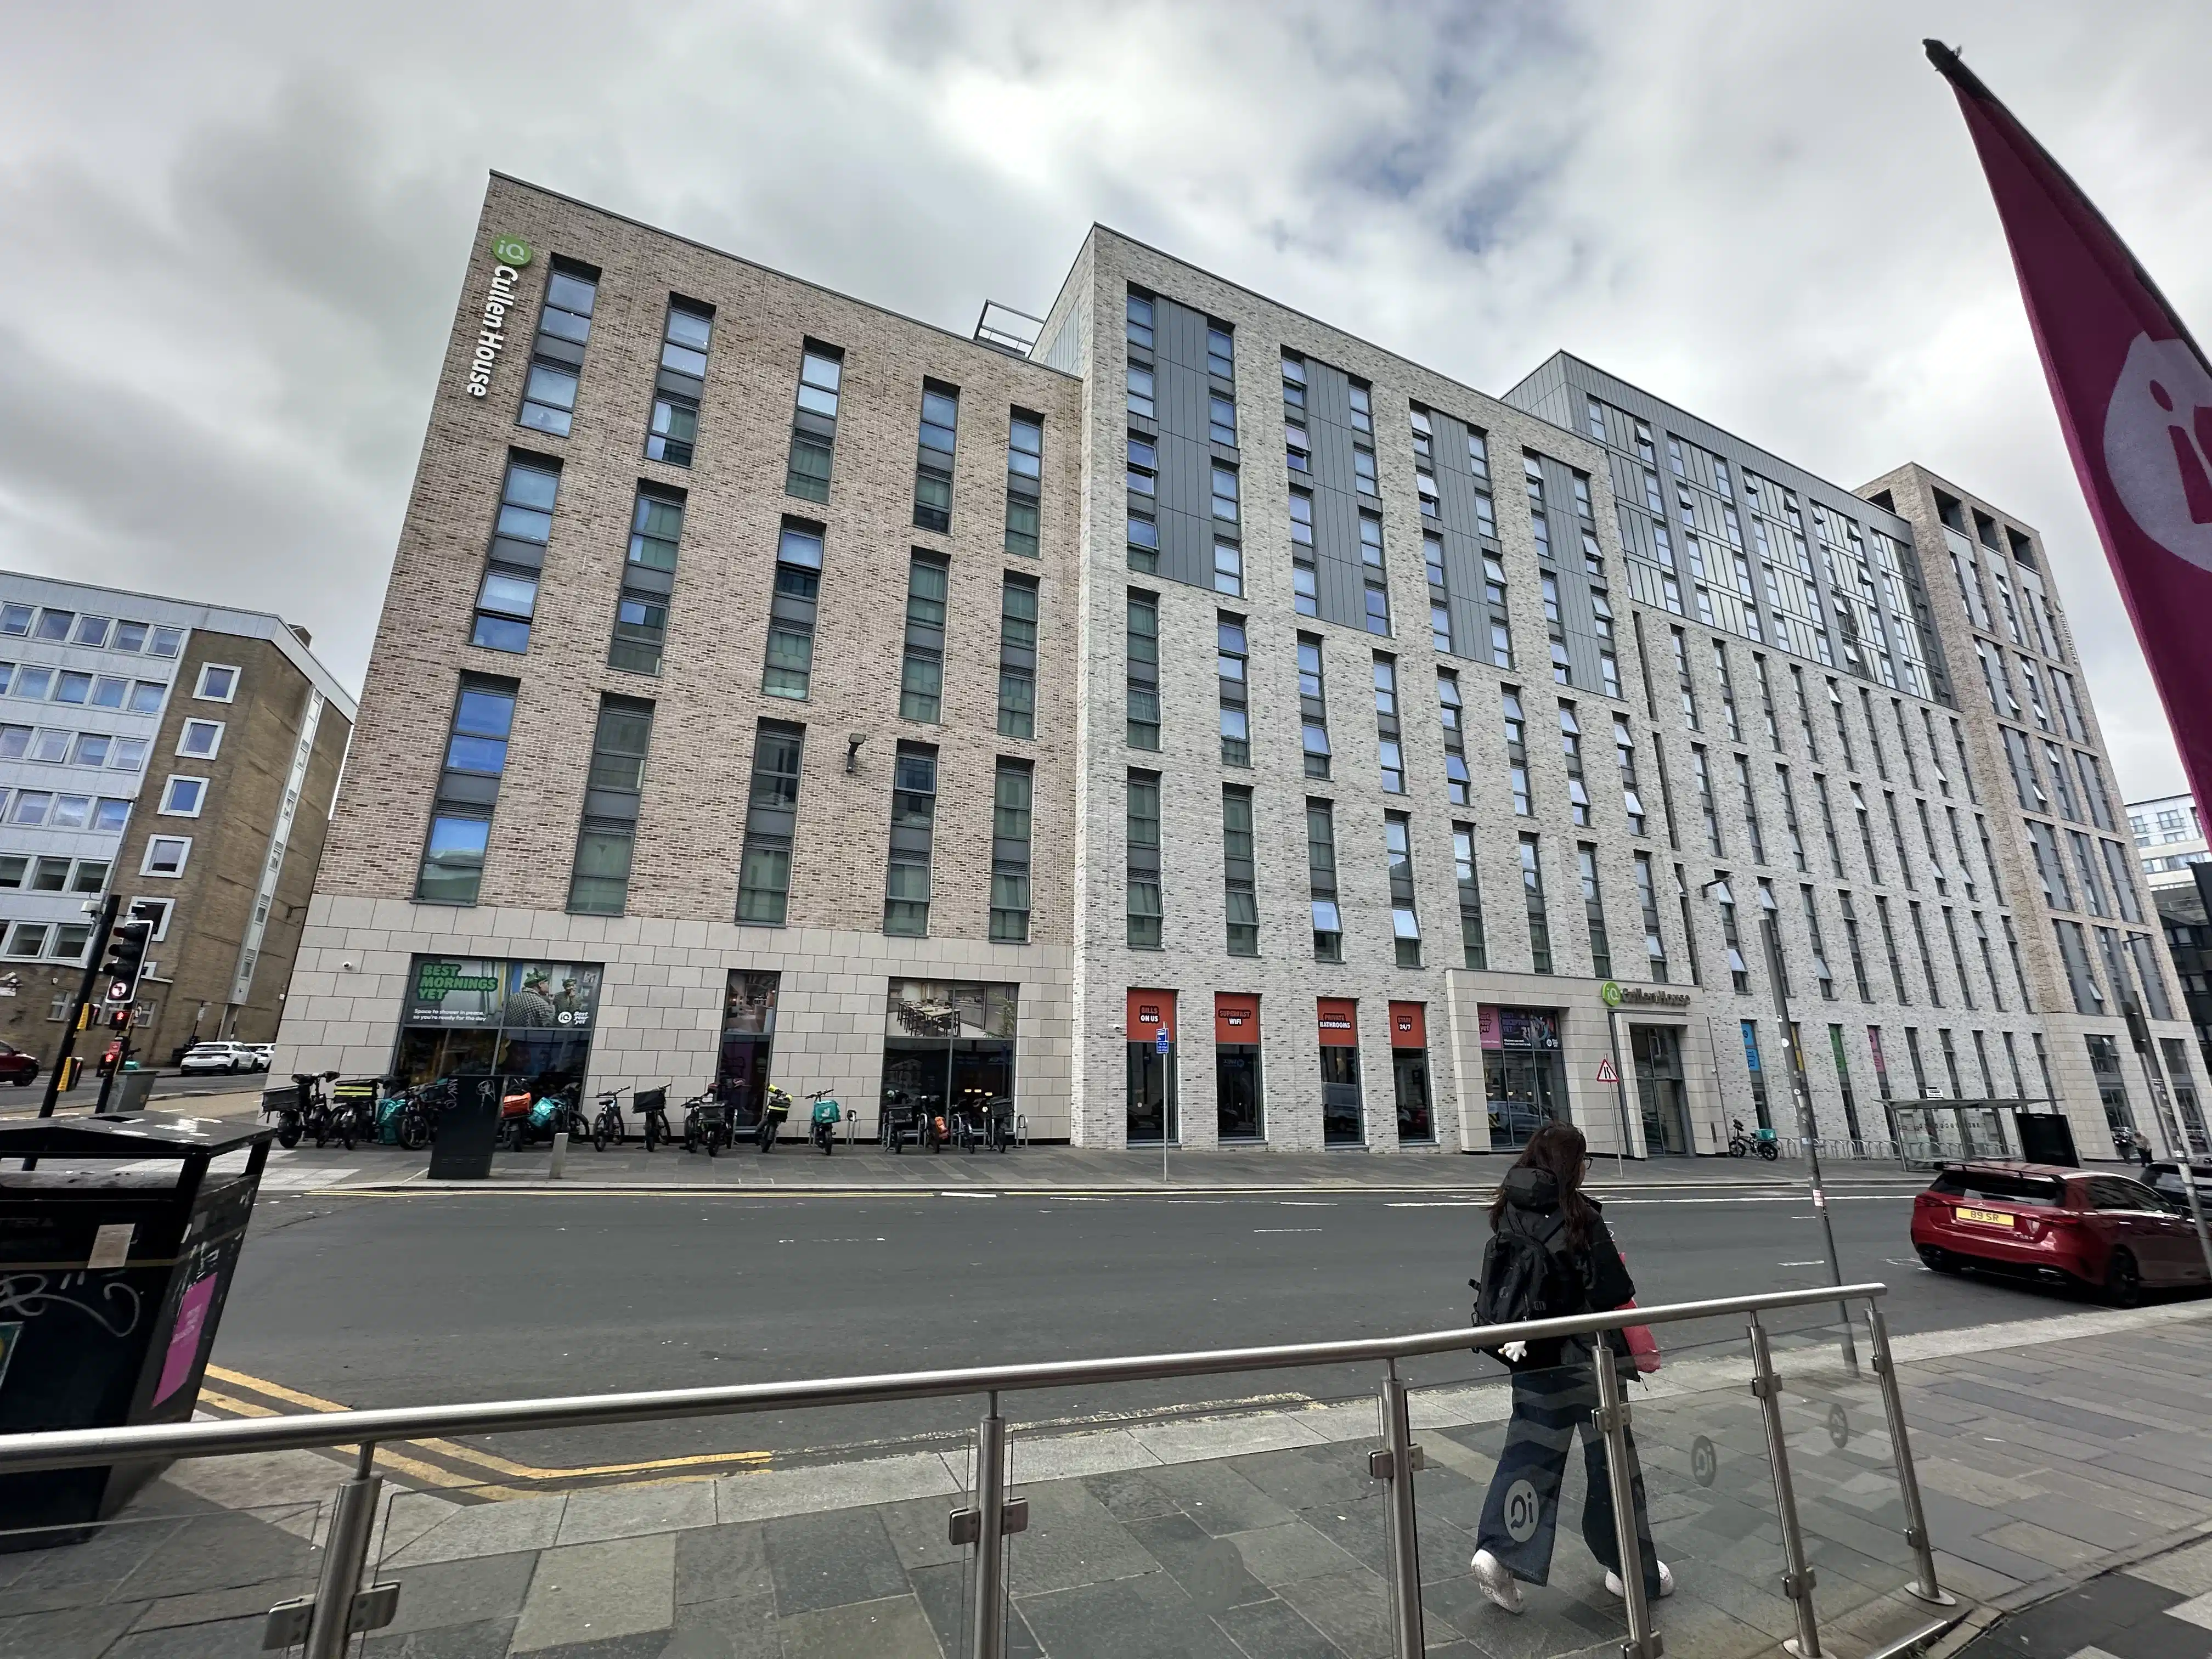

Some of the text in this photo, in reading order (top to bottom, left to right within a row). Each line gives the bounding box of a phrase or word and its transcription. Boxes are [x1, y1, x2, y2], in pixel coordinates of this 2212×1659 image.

[498, 240, 525, 261] iQ
[467, 265, 518, 397] Cullen House
[422, 964, 460, 977] BEST
[420, 977, 496, 990] MORNINGS
[418, 988, 446, 1000] YET
[1970, 1210, 2000, 1222] 89 SR
